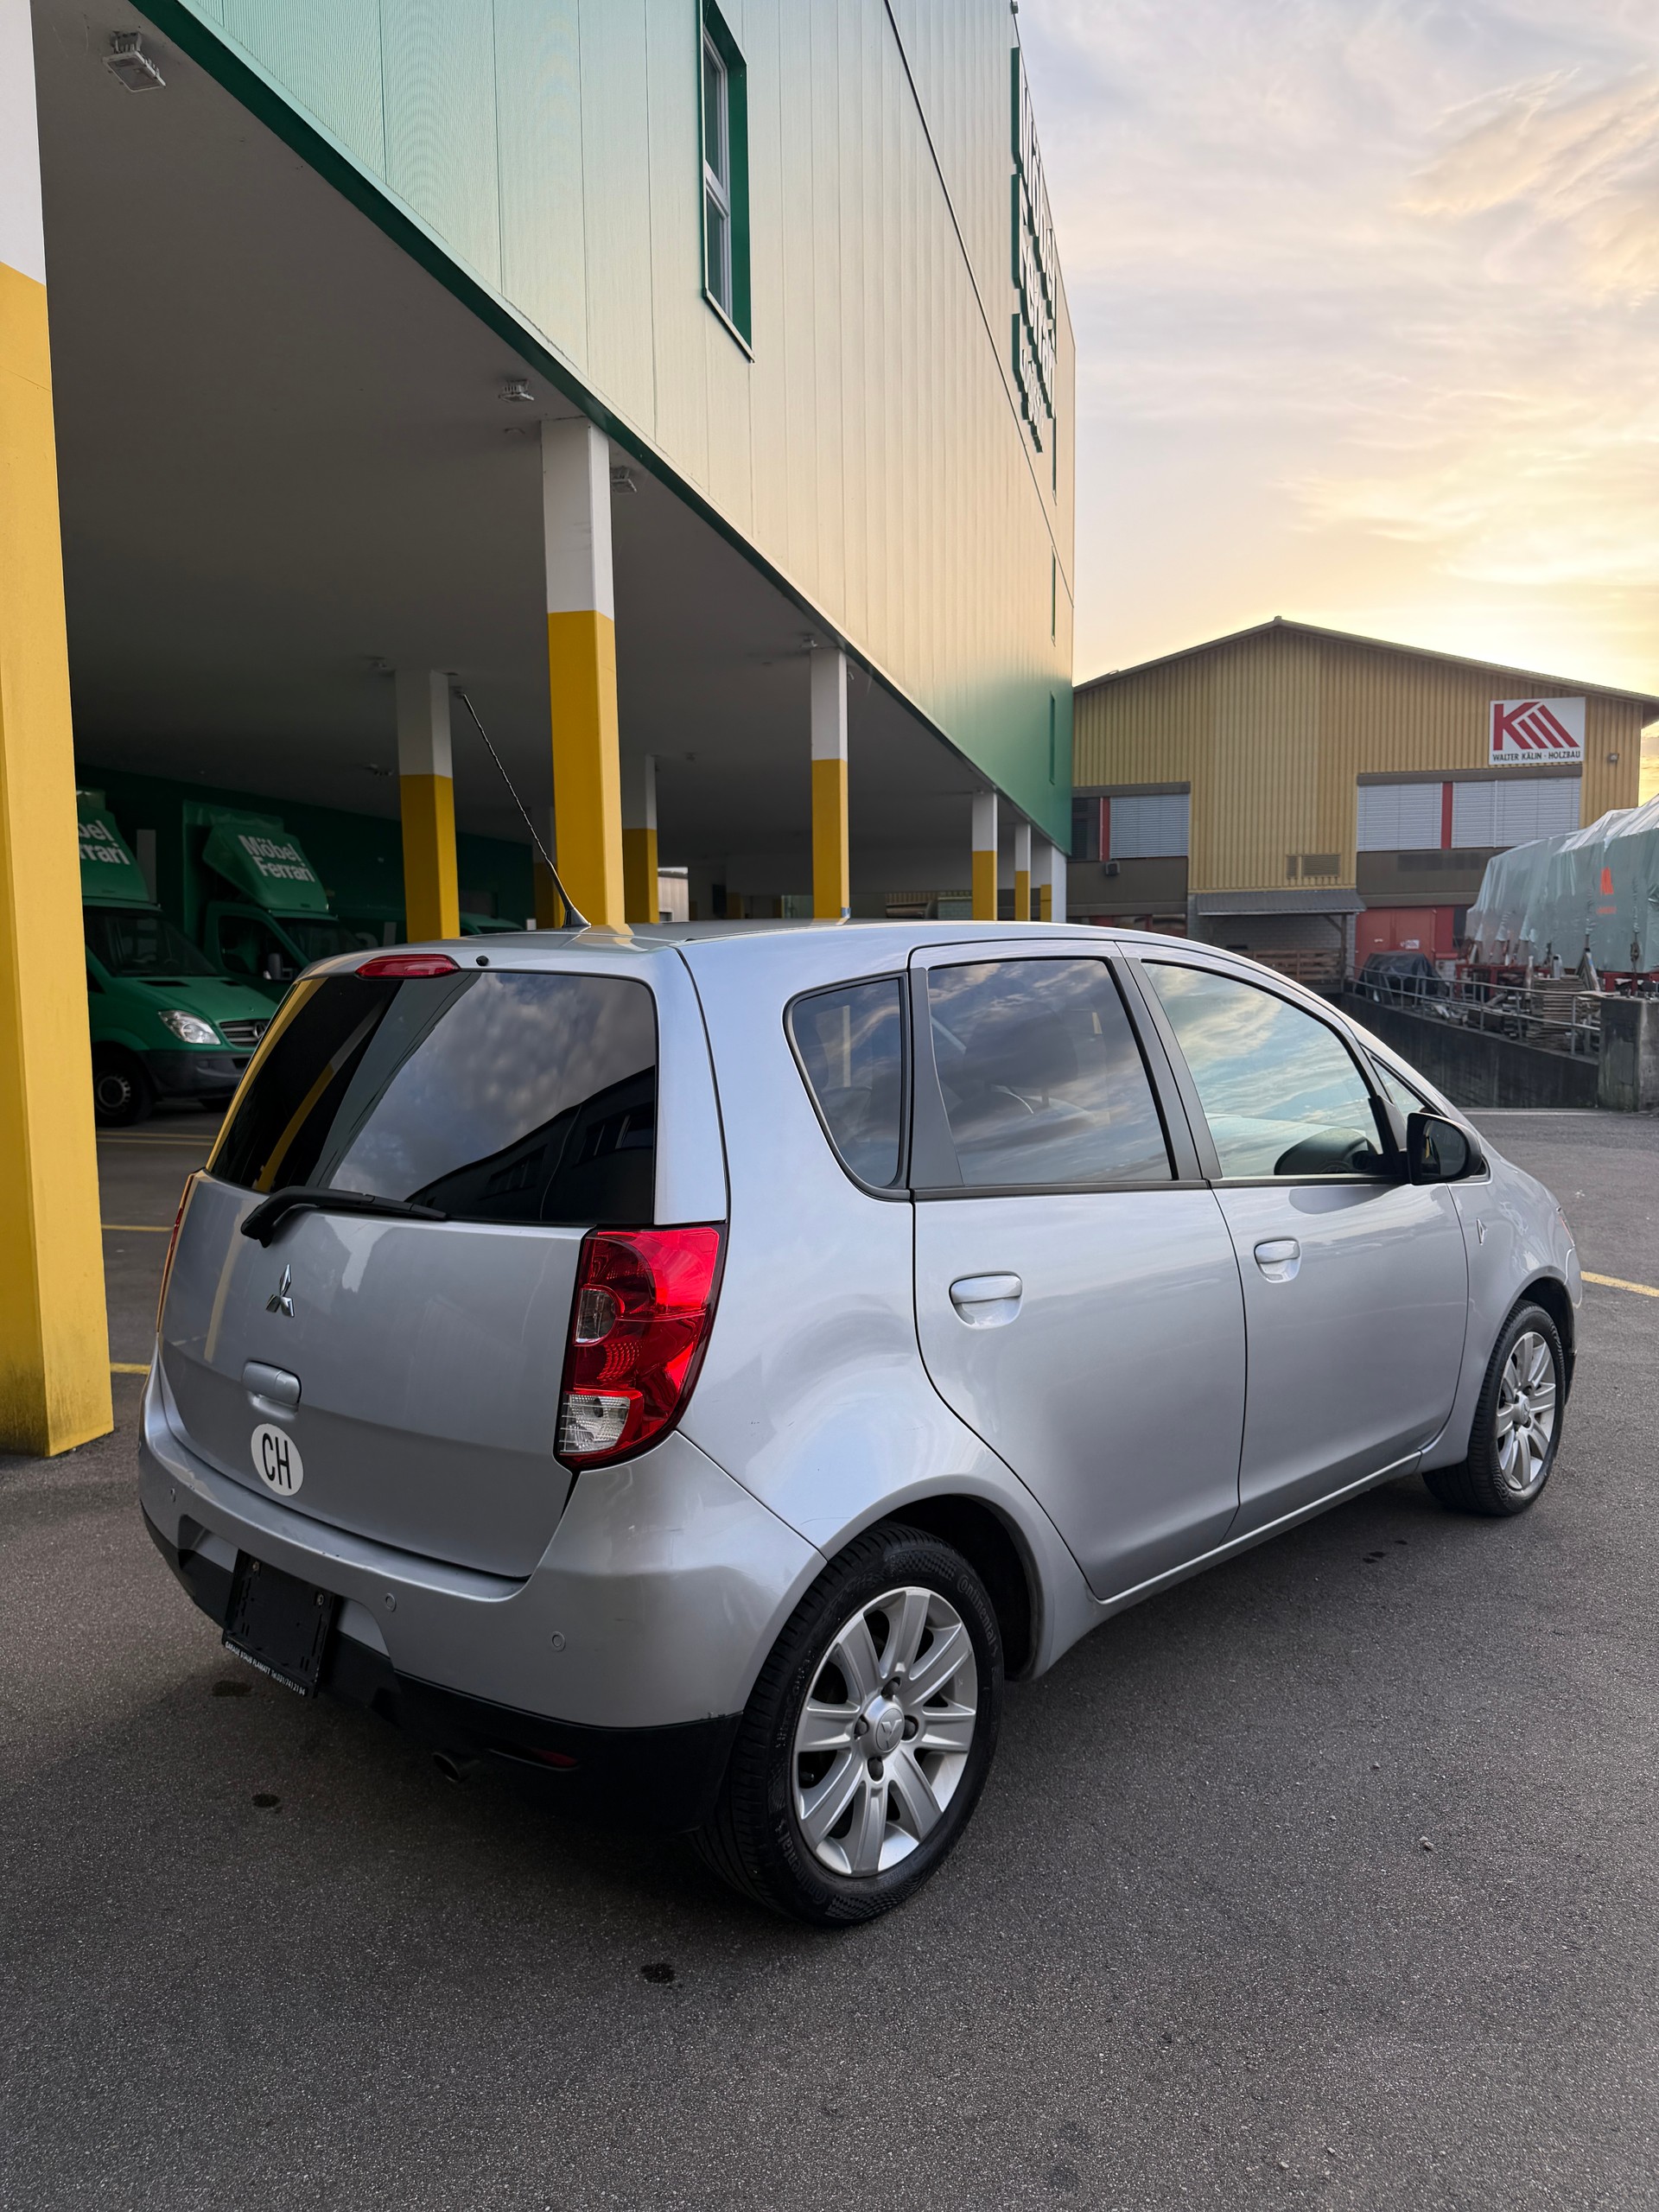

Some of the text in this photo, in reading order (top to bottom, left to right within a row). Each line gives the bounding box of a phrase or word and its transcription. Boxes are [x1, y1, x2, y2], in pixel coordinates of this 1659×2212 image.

[1522, 752, 1542, 760] KÄLIN
[1548, 751, 1580, 760] HOLZBAU
[238, 835, 302, 861] Möbel
[252, 855, 315, 882] Ferrari
[262, 1433, 292, 1490] CH
[225, 1641, 240, 1656] GARAGE
[252, 1658, 270, 1675] FLAMATT
